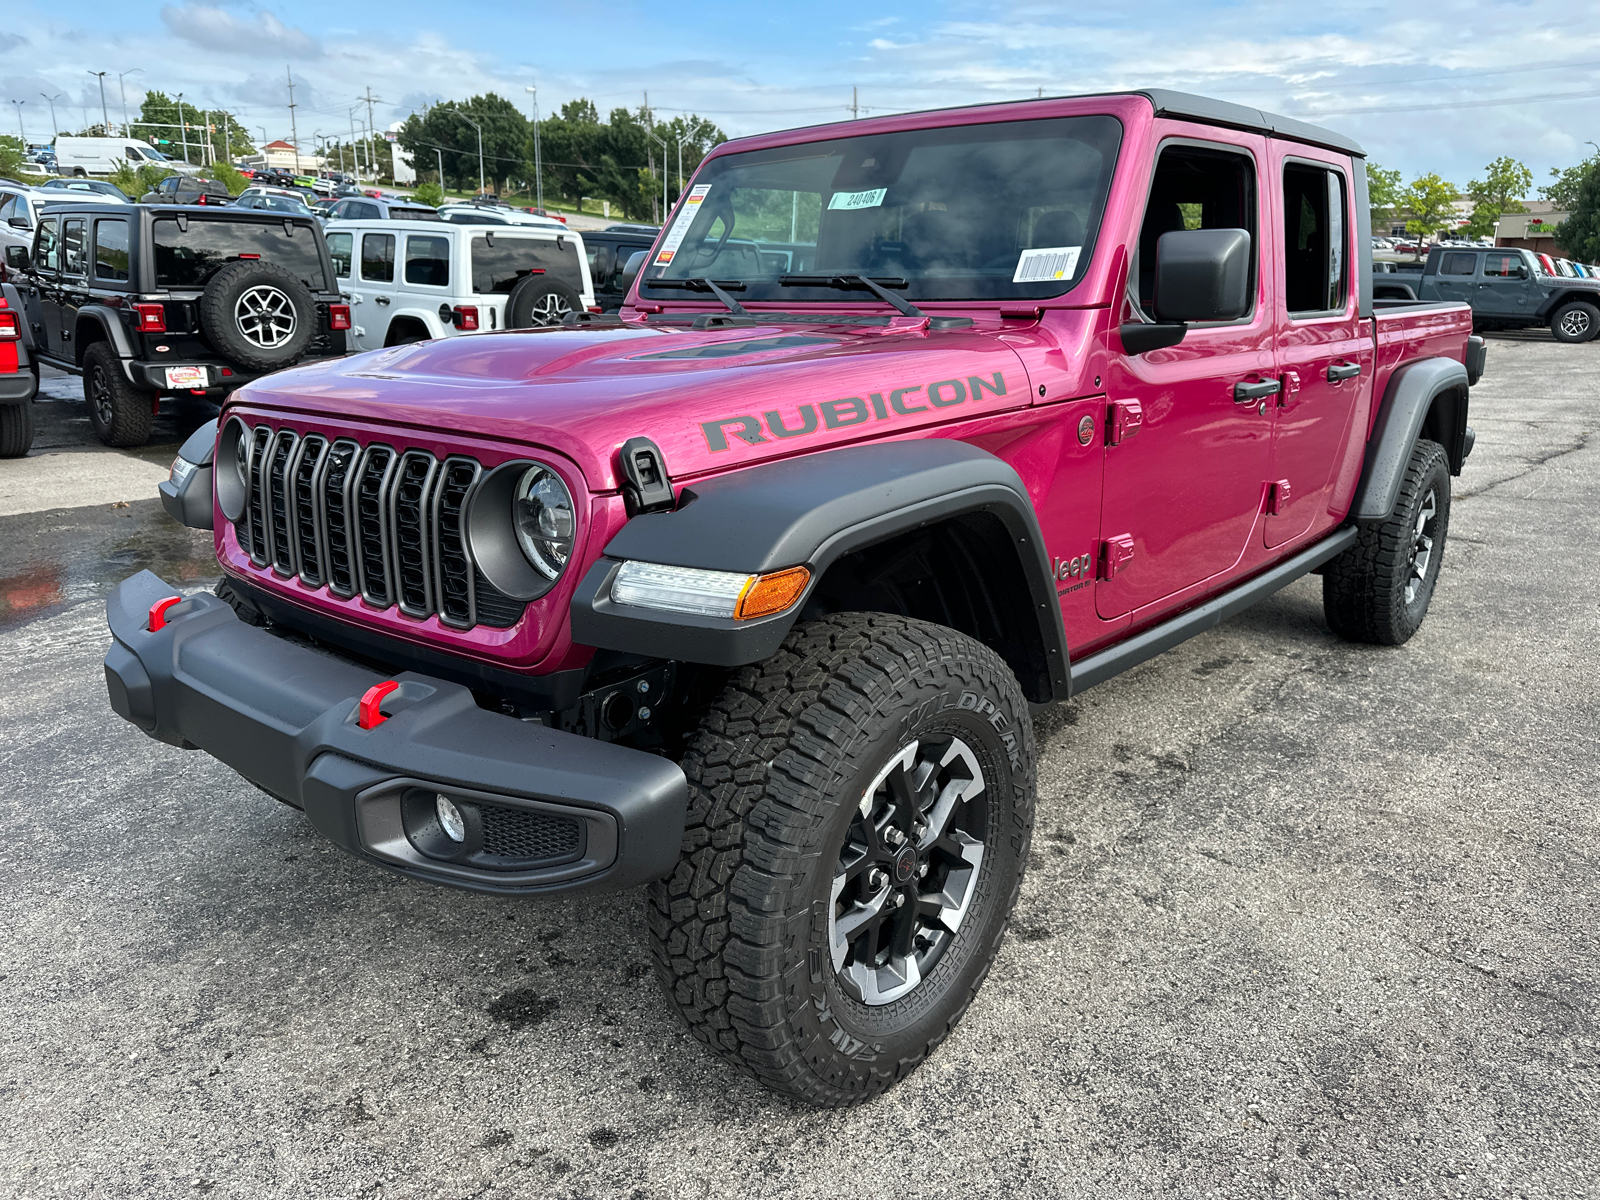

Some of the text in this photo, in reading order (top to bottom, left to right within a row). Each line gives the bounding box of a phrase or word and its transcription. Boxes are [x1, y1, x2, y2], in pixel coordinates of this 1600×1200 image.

[847, 191, 877, 206] 240406
[701, 371, 1008, 454] RUBICON
[1053, 553, 1091, 580] Jeep
[899, 690, 1024, 777] WILDPEAK
